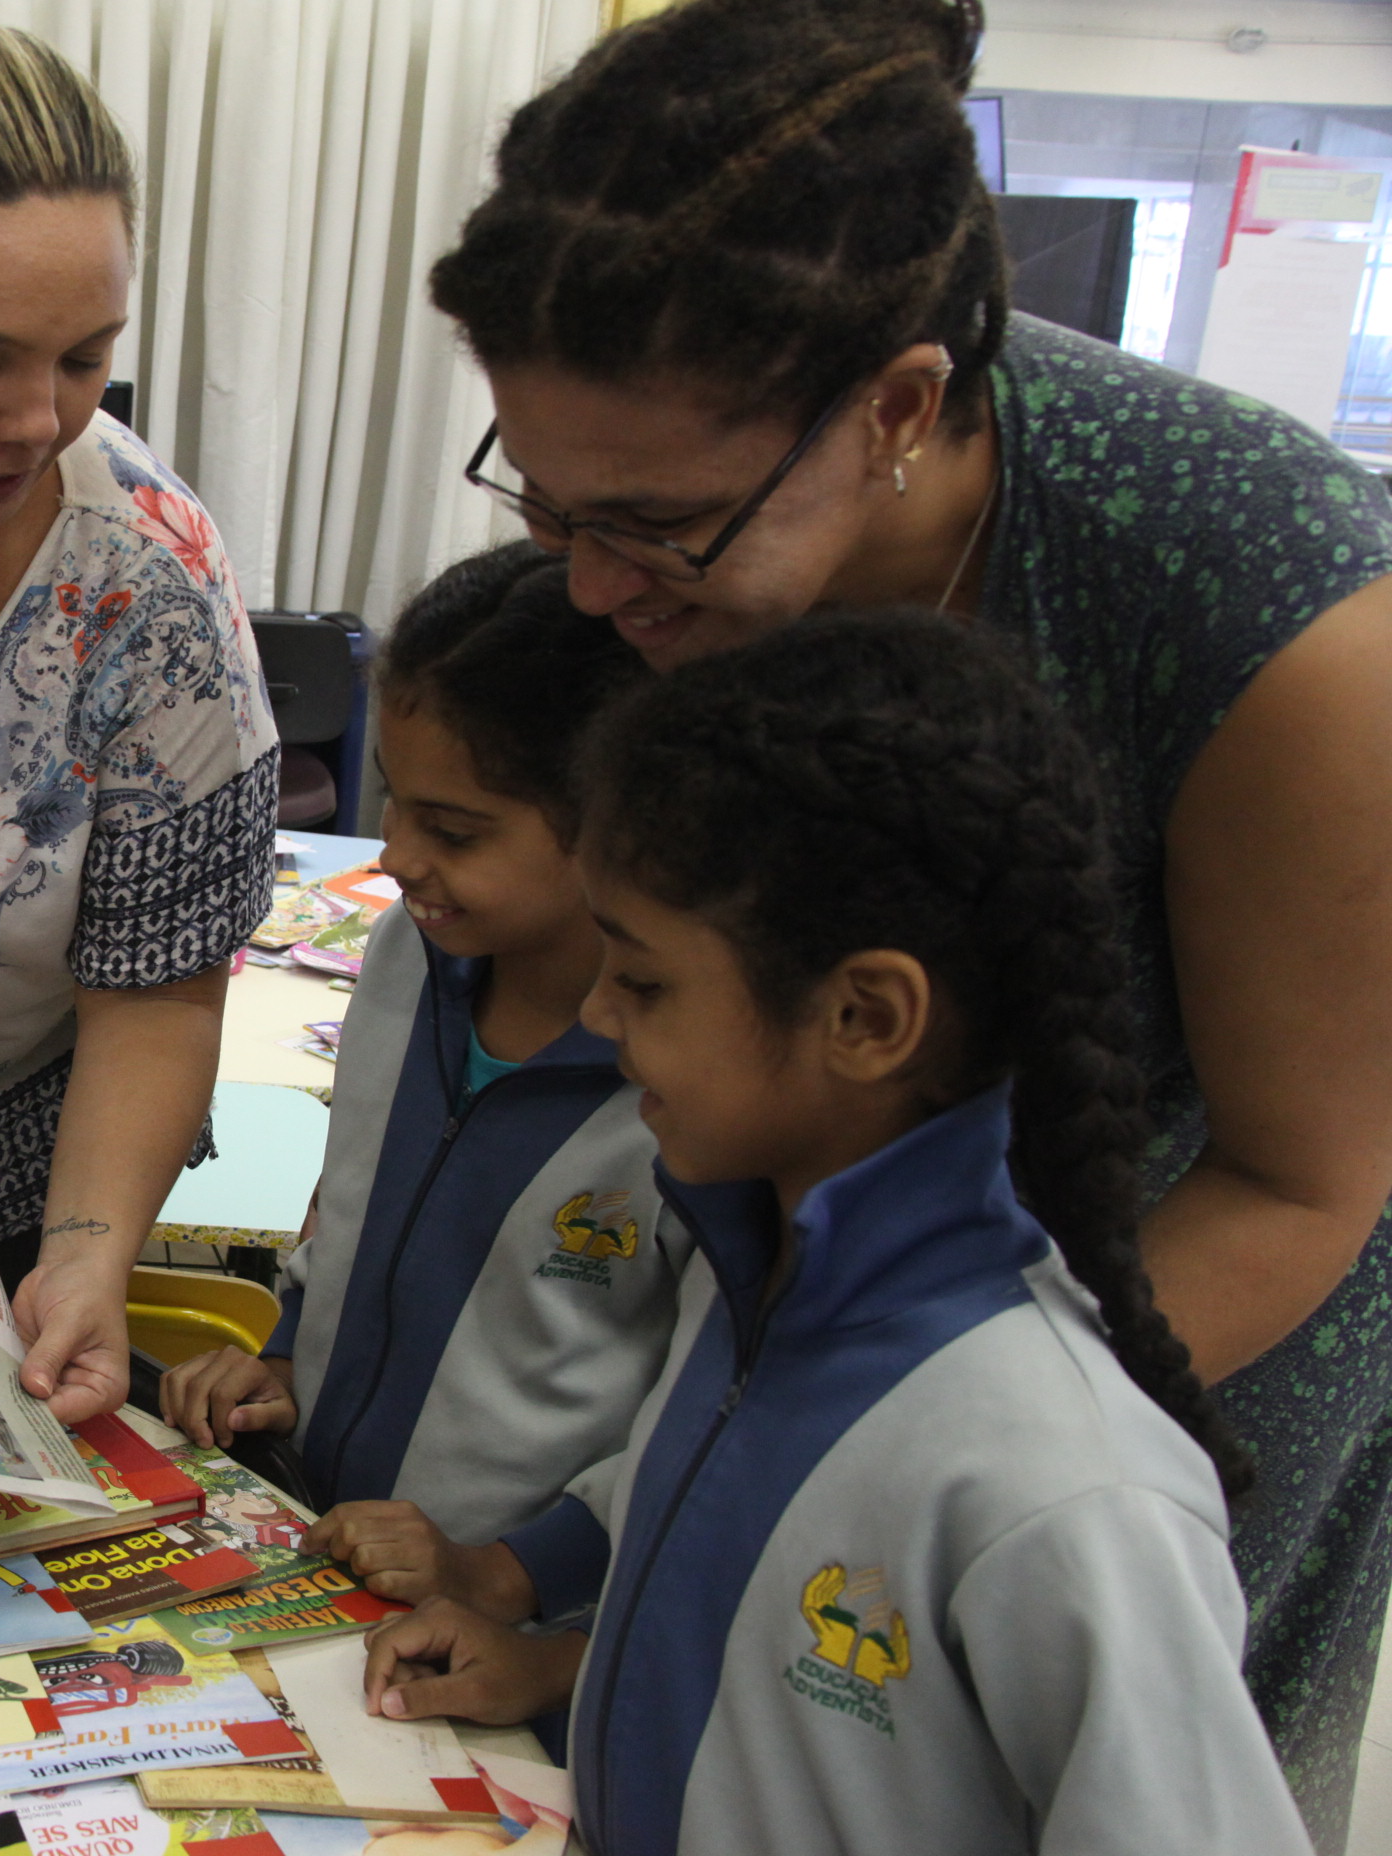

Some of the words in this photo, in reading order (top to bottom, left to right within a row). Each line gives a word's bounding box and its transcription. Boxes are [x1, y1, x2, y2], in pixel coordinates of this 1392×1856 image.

[548, 1253, 611, 1274] EDUCAÇÃO
[533, 1264, 612, 1289] ADVENTISTA
[123, 1531, 168, 1550] da
[44, 1543, 131, 1574] Flore
[175, 1566, 356, 1617] DESAPARECIDO
[797, 1656, 890, 1714] EDUCAÇÃO
[783, 1665, 896, 1741] ADVENTISTA
[32, 1825, 70, 1843] SE
[76, 1814, 140, 1836] AVES
